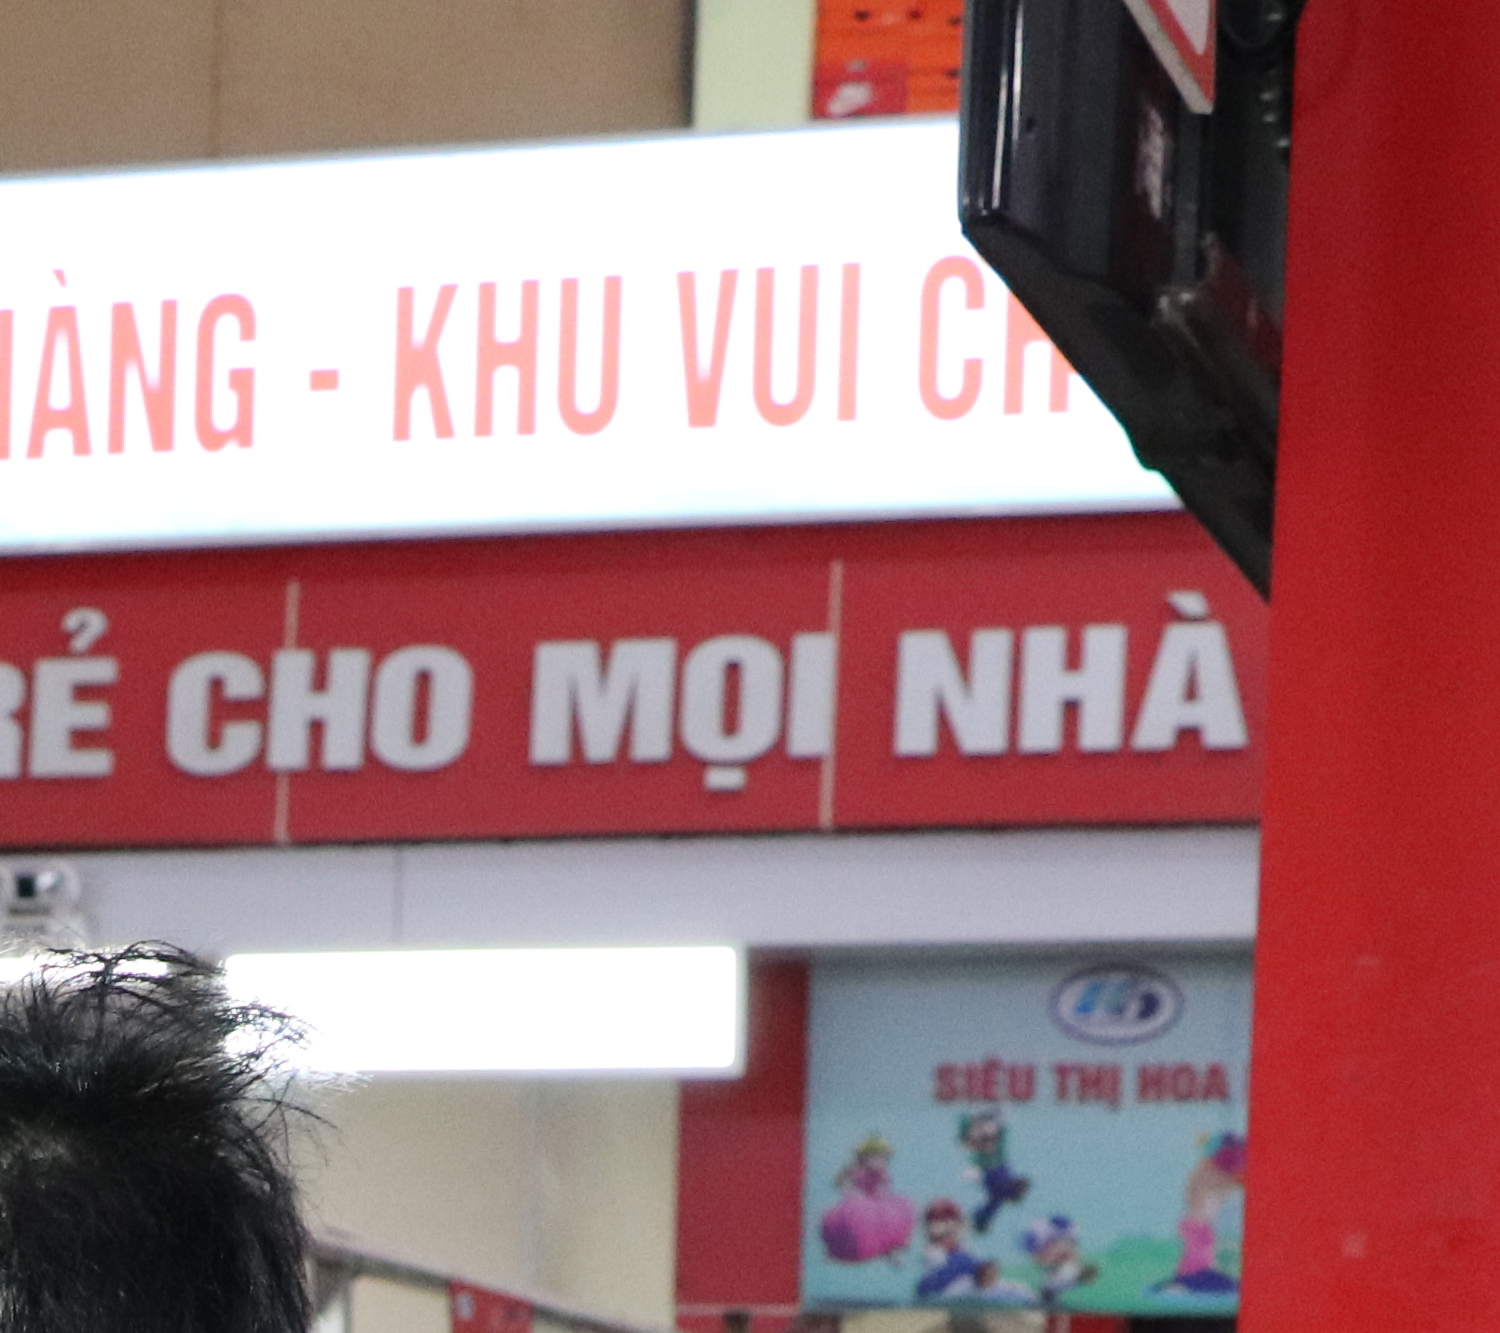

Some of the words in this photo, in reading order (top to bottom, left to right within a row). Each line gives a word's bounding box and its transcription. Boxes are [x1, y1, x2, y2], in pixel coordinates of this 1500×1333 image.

[392, 273, 623, 443] KHU
[677, 260, 864, 429] VUI
[163, 644, 475, 777] CHO
[529, 632, 836, 790] MỌI
[893, 588, 1250, 756] NHÀ
[933, 1057, 1036, 1103] SIÊU
[1053, 1062, 1123, 1111] THỊ
[1137, 1062, 1230, 1104] HOA
